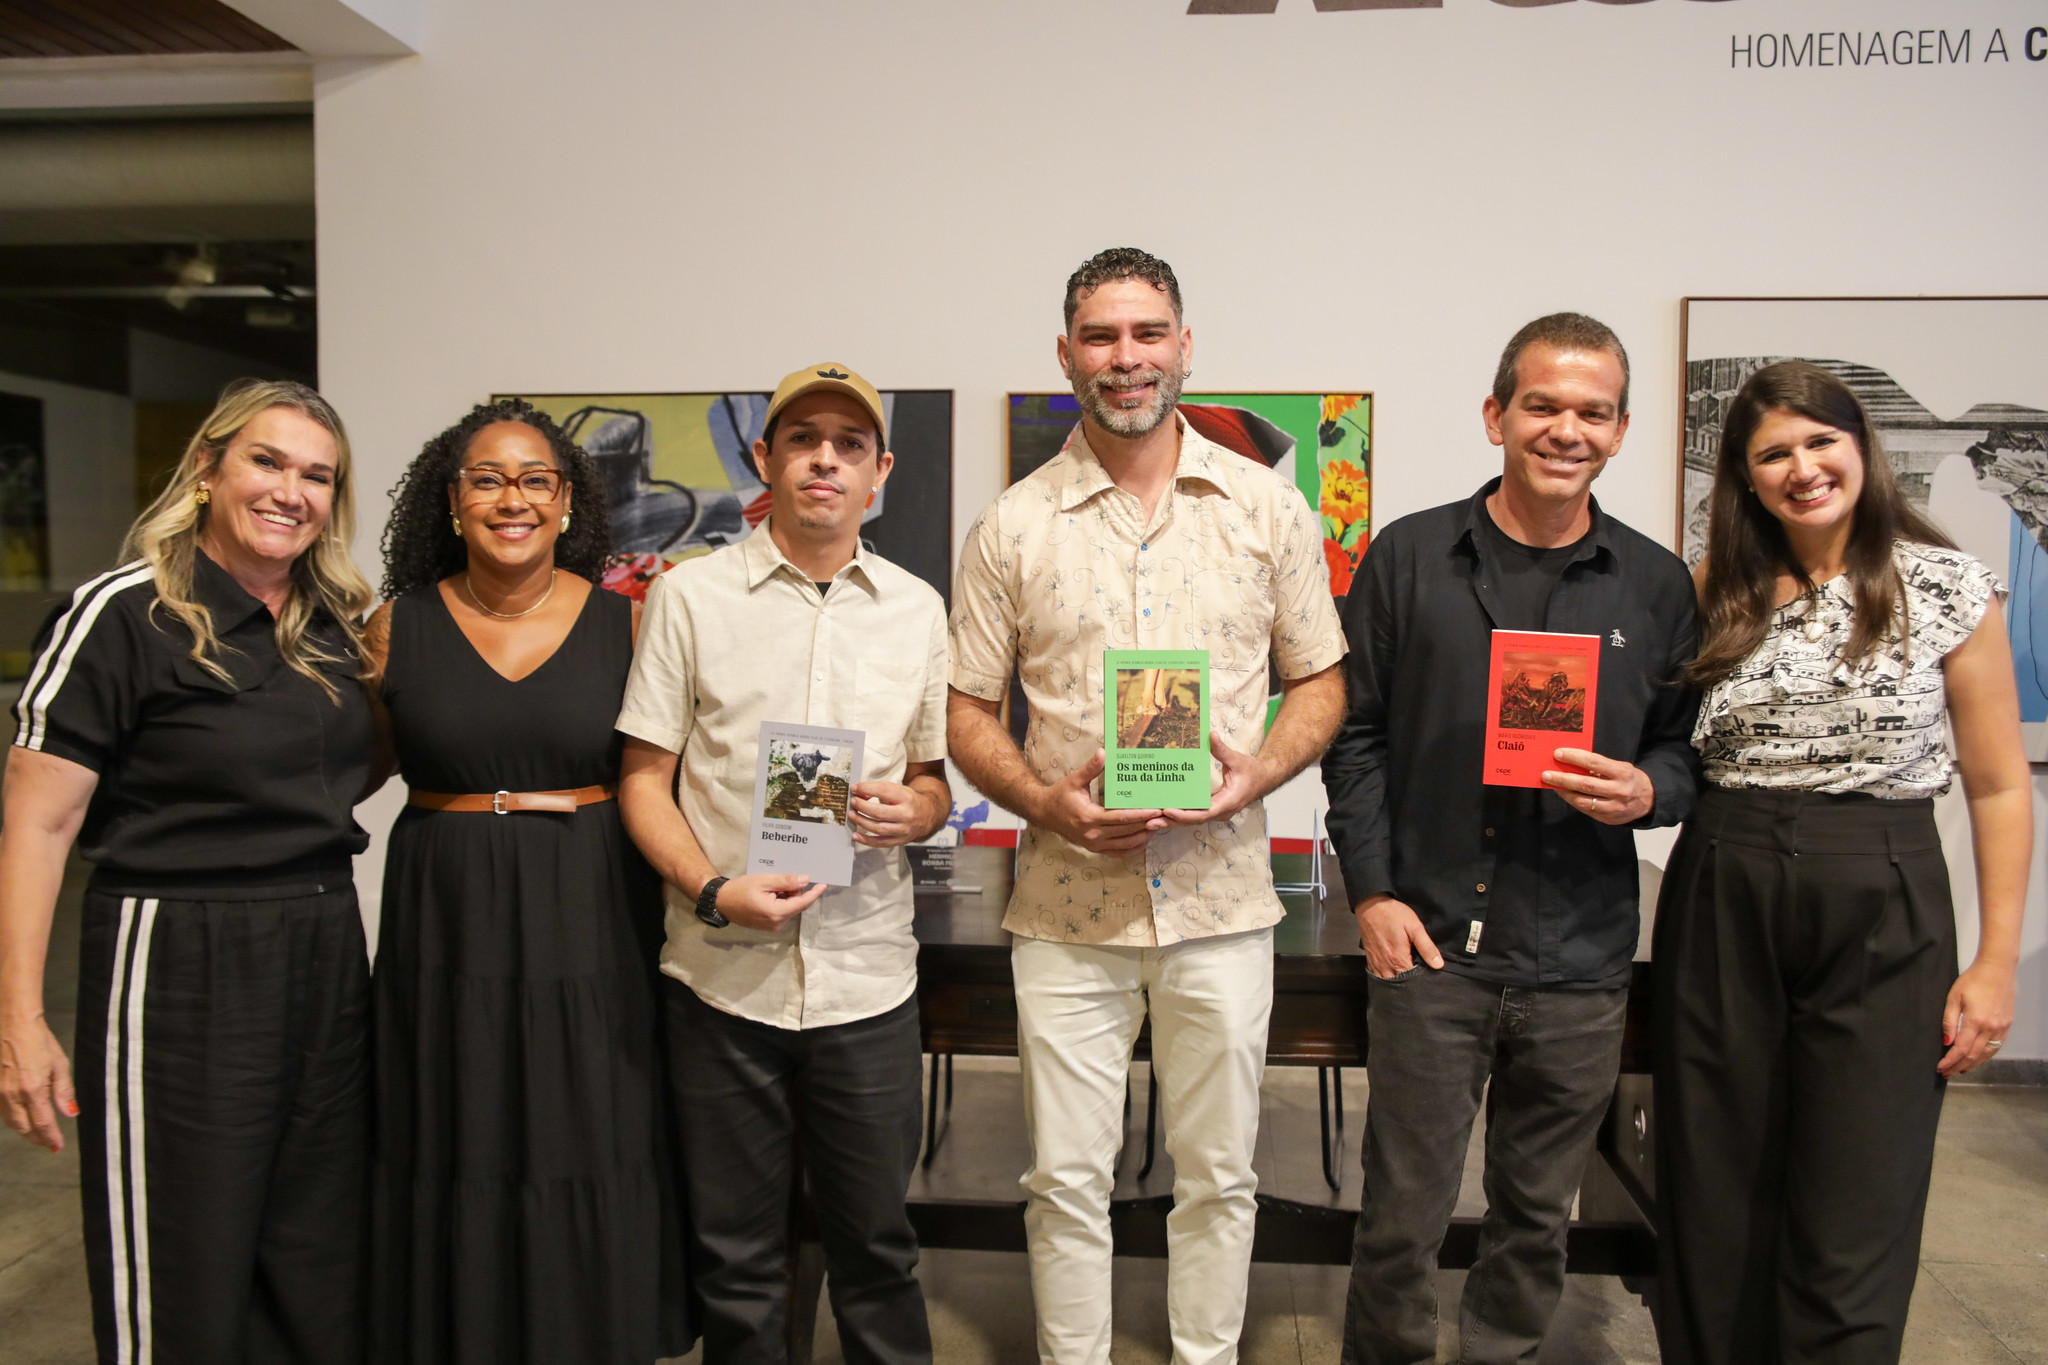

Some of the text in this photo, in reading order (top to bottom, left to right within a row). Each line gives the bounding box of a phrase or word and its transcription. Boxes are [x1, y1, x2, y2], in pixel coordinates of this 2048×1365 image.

[1732, 29, 1971, 69] HOMENAGEM
[1984, 28, 2010, 63] A
[1116, 761, 1194, 772] Os meninos da
[1116, 772, 1185, 782] Rua da Linha
[761, 831, 808, 844] Beberibe
